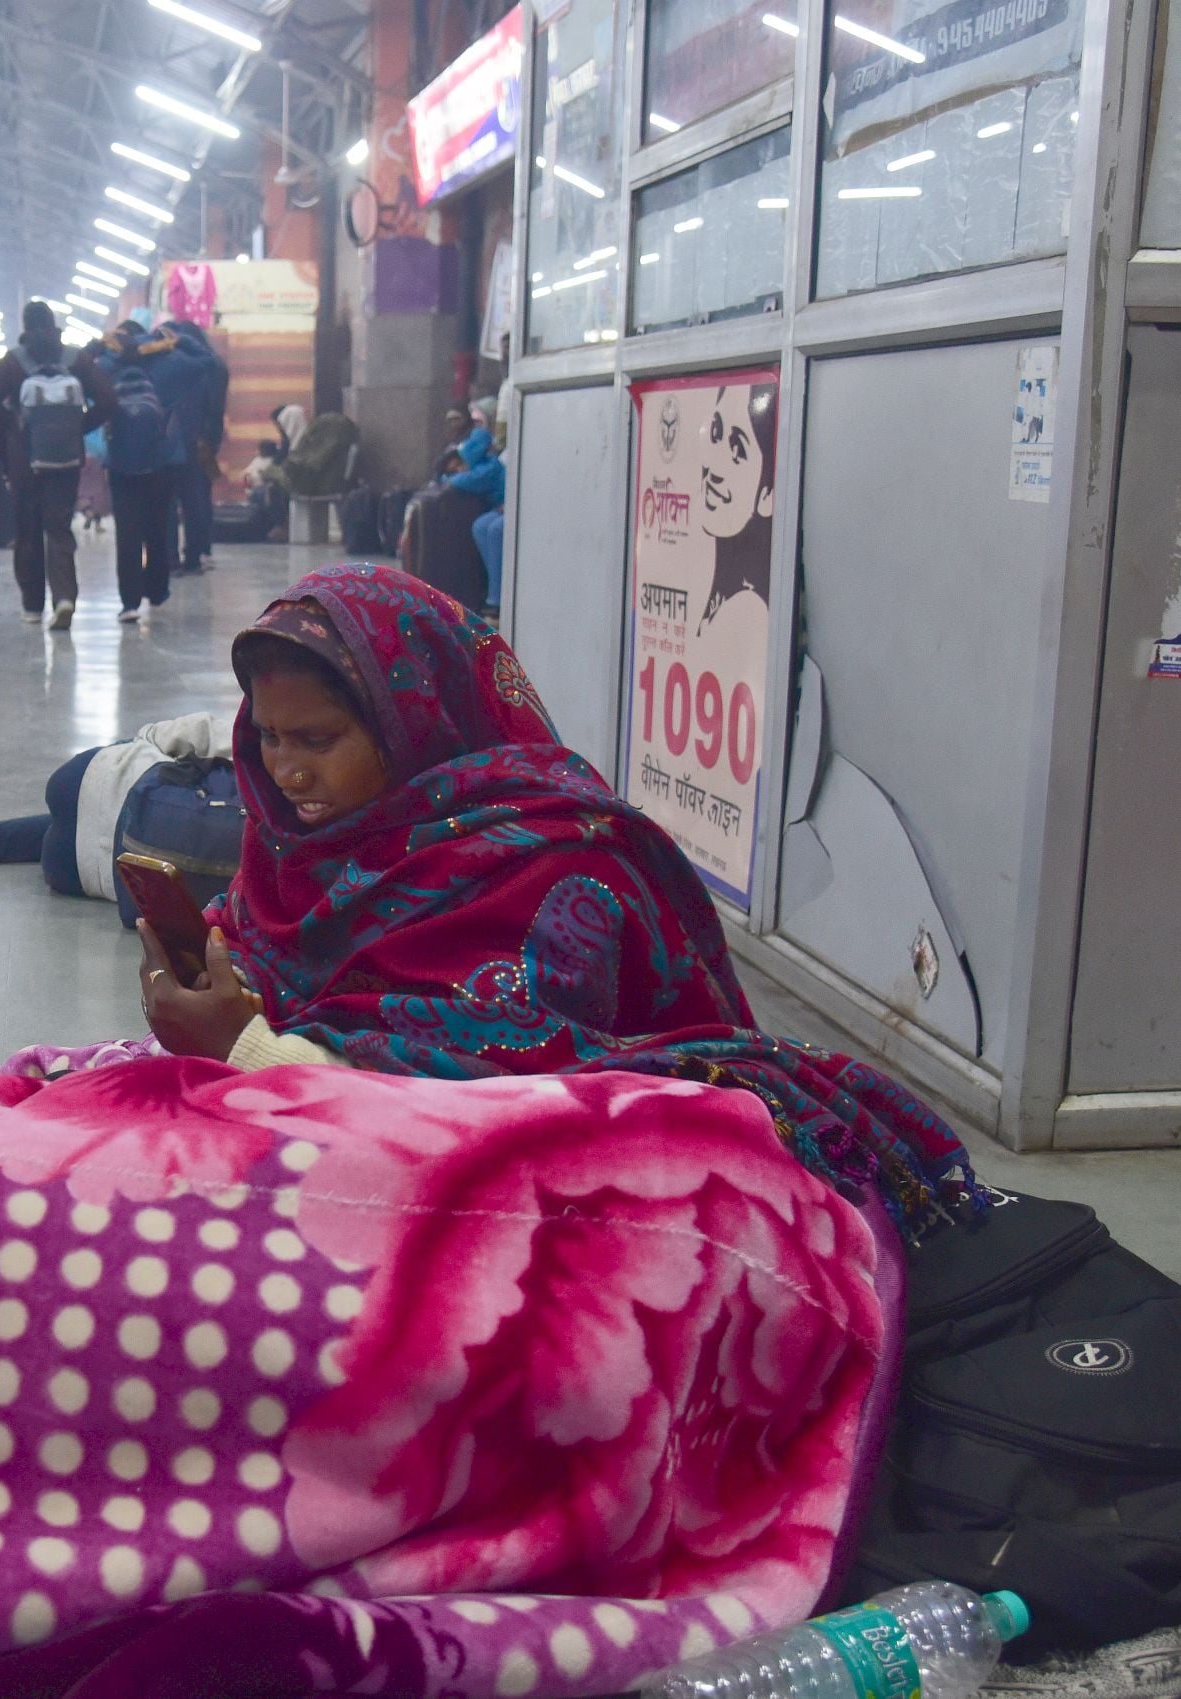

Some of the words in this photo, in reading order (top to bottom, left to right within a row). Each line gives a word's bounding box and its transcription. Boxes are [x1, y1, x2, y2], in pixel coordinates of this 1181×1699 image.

[641, 583, 688, 622] अपमान
[639, 656, 756, 785] 1090
[641, 753, 671, 801] वीमेन
[675, 773, 706, 816] पॉवर
[707, 794, 742, 838] लाइन
